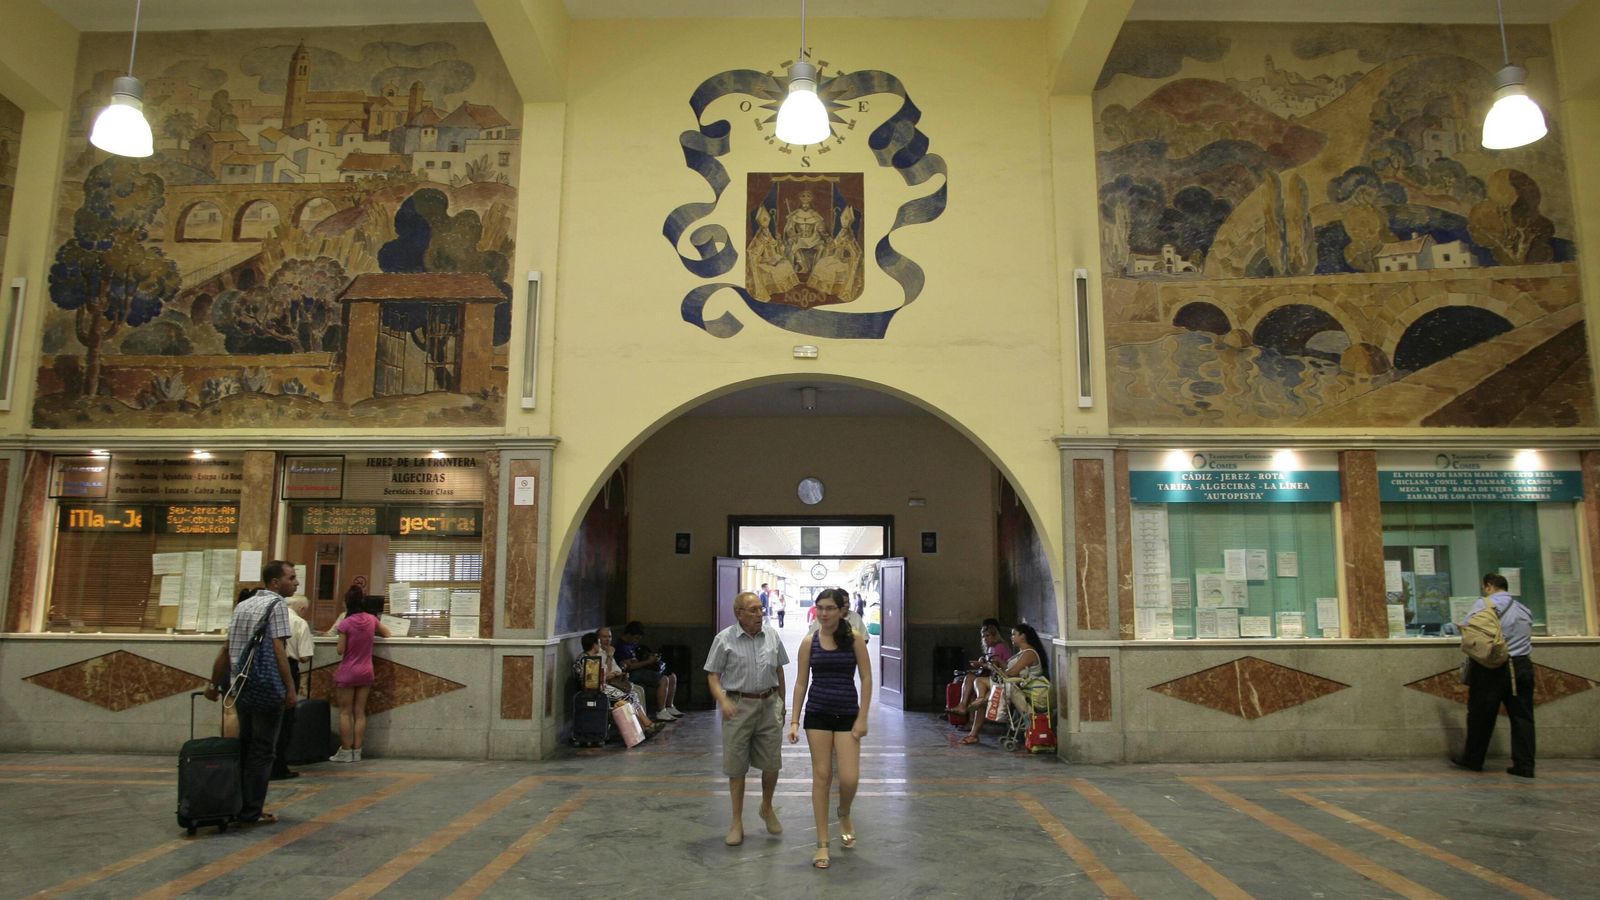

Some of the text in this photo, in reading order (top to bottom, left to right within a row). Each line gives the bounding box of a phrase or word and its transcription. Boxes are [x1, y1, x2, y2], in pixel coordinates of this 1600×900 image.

[740, 101, 752, 112] O
[858, 101, 869, 112] E
[801, 156, 810, 167] S
[366, 458, 476, 467] JEREZ DE LA FRONTERA
[392, 473, 445, 482] ALGECIRAS
[1182, 472, 1212, 481] CÁDIZ
